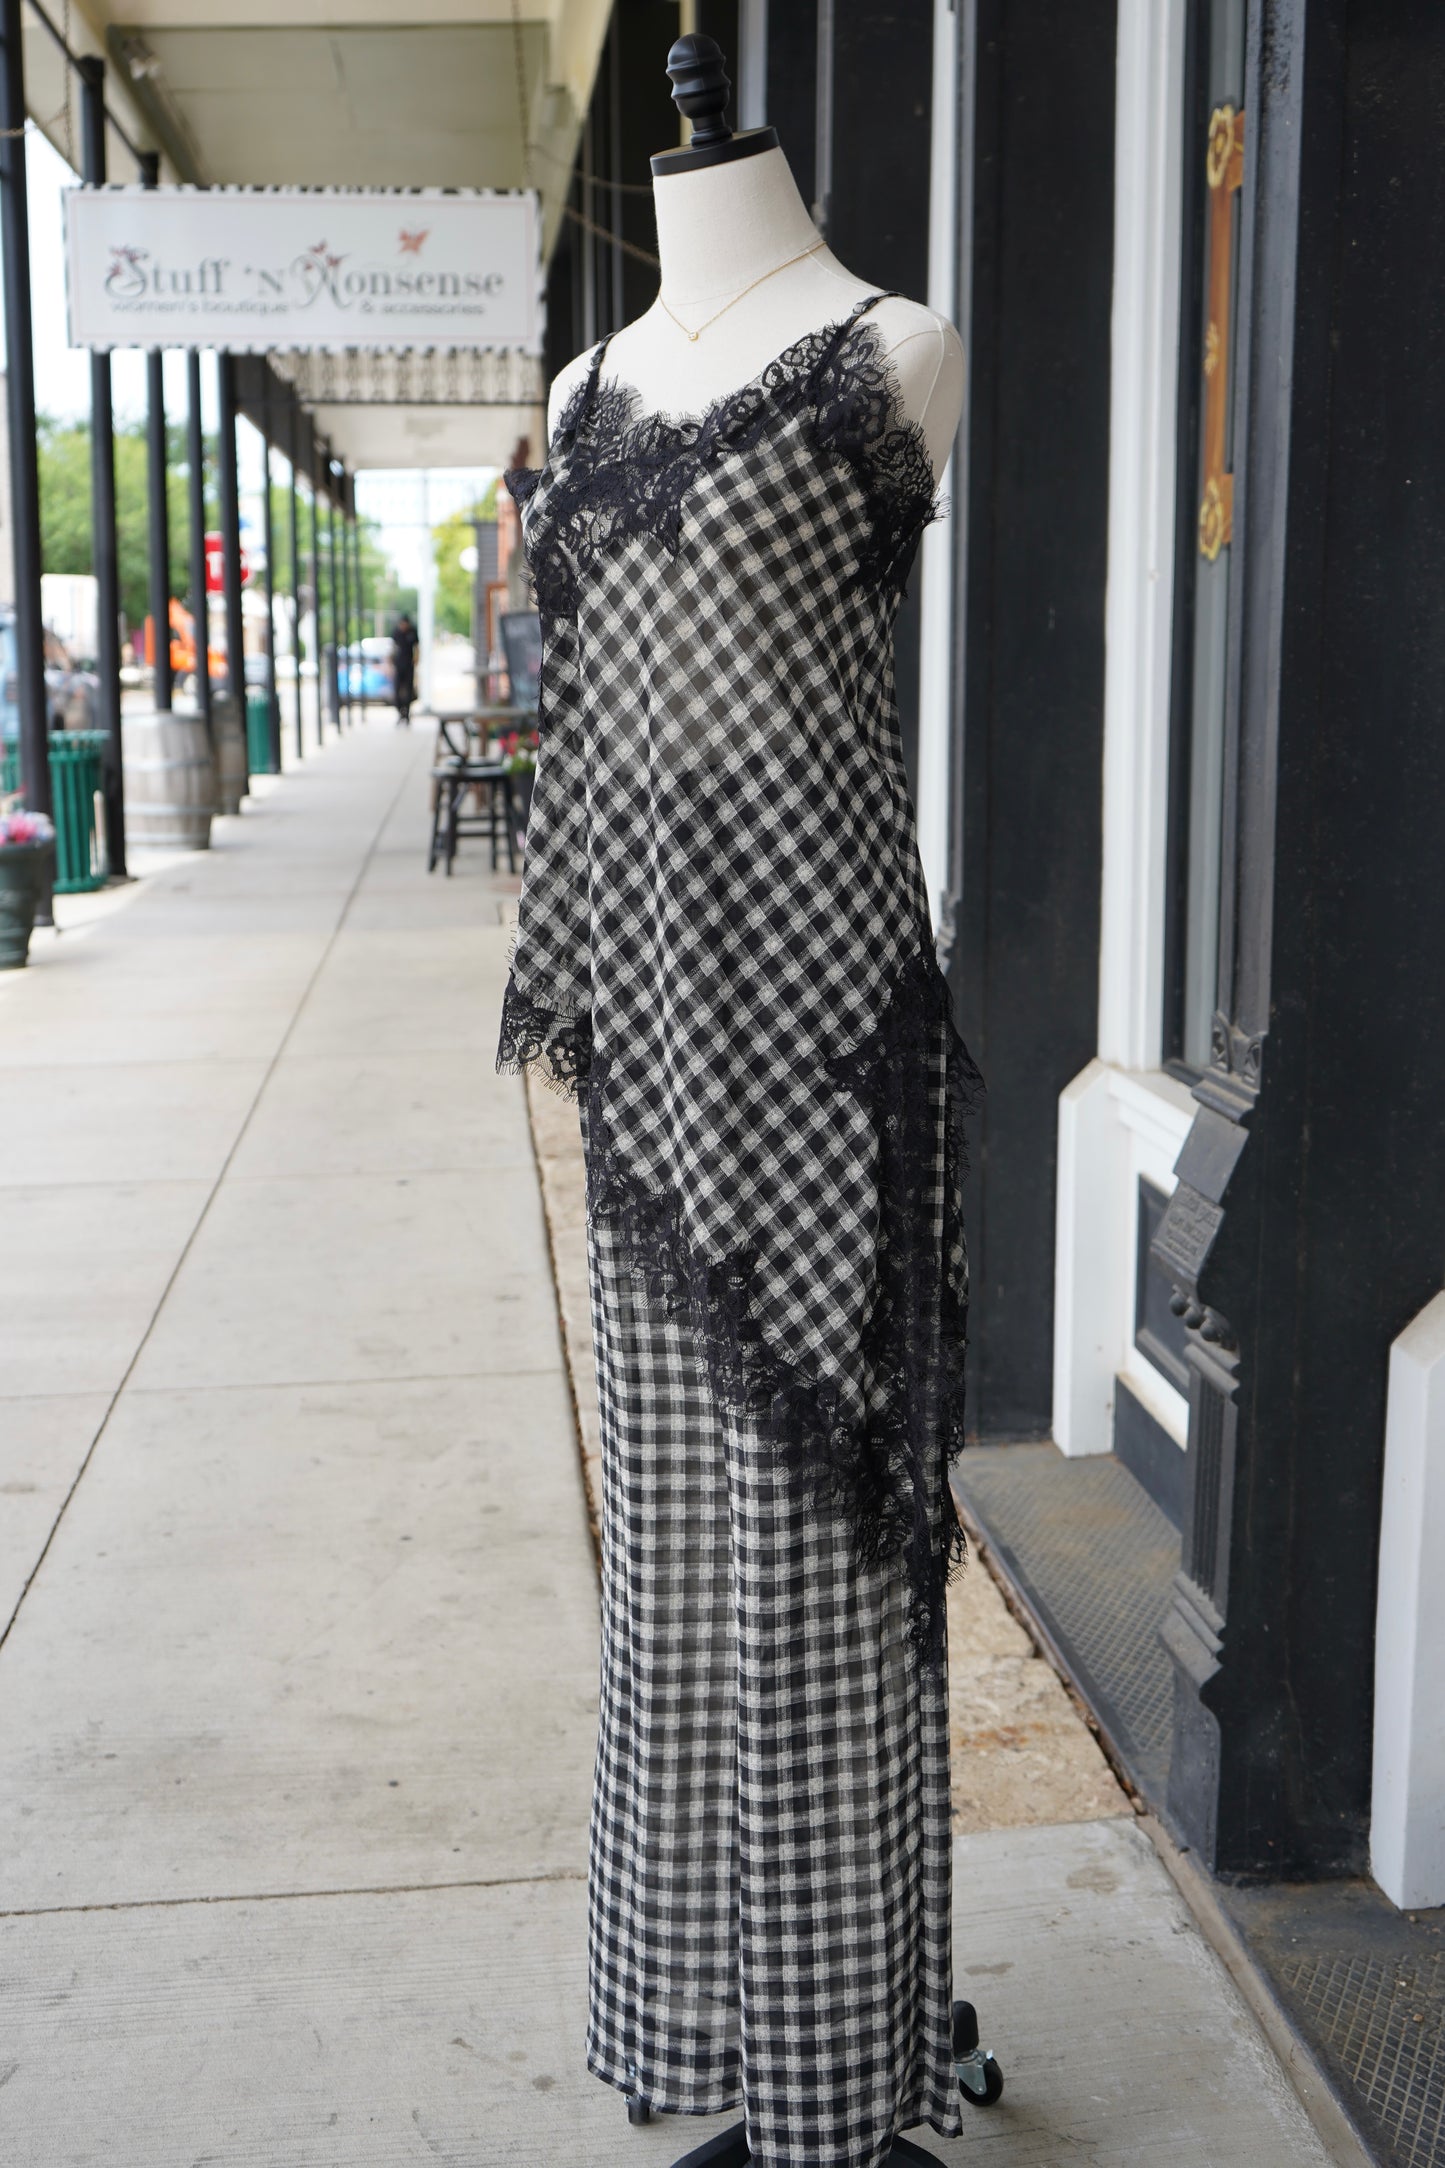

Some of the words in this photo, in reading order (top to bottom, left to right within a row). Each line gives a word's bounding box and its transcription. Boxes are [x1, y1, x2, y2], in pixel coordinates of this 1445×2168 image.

[104, 246, 231, 298] Stuff
[289, 253, 504, 310] Nonsense
[203, 300, 289, 316] boutique
[360, 300, 374, 314] &
[381, 301, 485, 315] accessories
